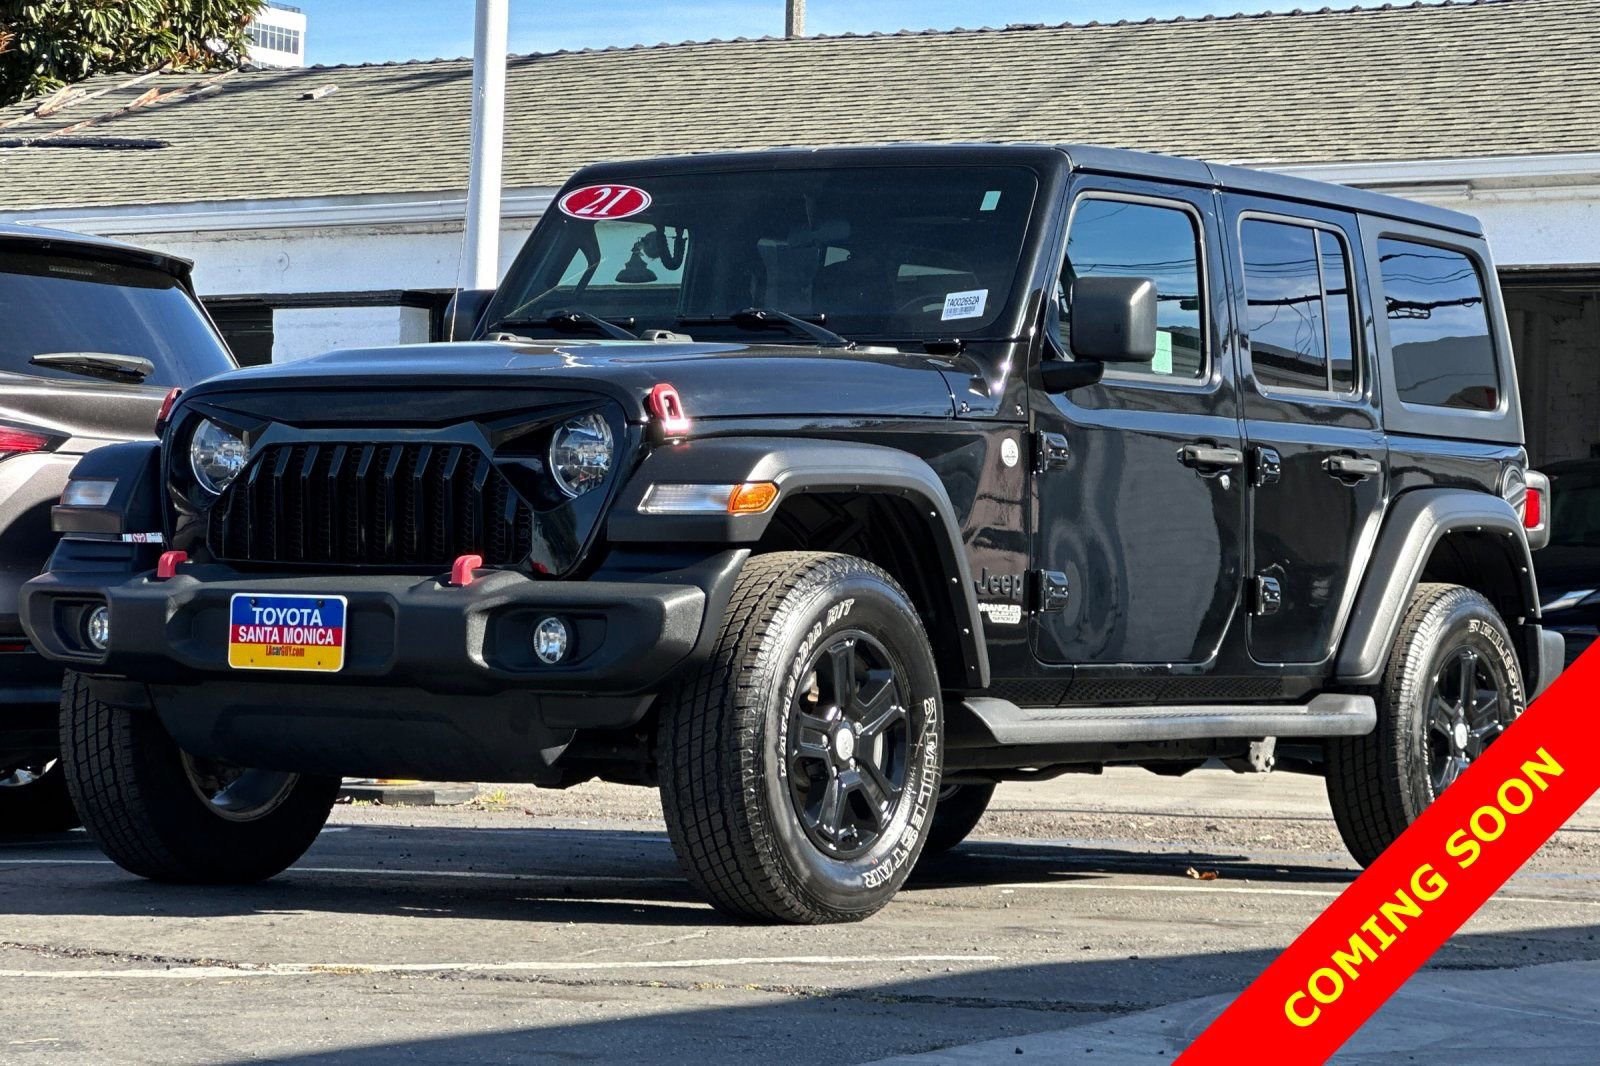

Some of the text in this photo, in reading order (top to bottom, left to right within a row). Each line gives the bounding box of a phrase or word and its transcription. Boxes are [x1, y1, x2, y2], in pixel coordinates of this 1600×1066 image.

[574, 187, 632, 215] 21
[974, 567, 1023, 600] Jeep
[252, 607, 323, 627] TOYOTA
[977, 602, 1021, 613] WRANGLER
[238, 625, 335, 645] SANTA MONICA
[265, 645, 305, 657] LAcarGUY.com
[861, 732, 938, 888] MILESTAR
